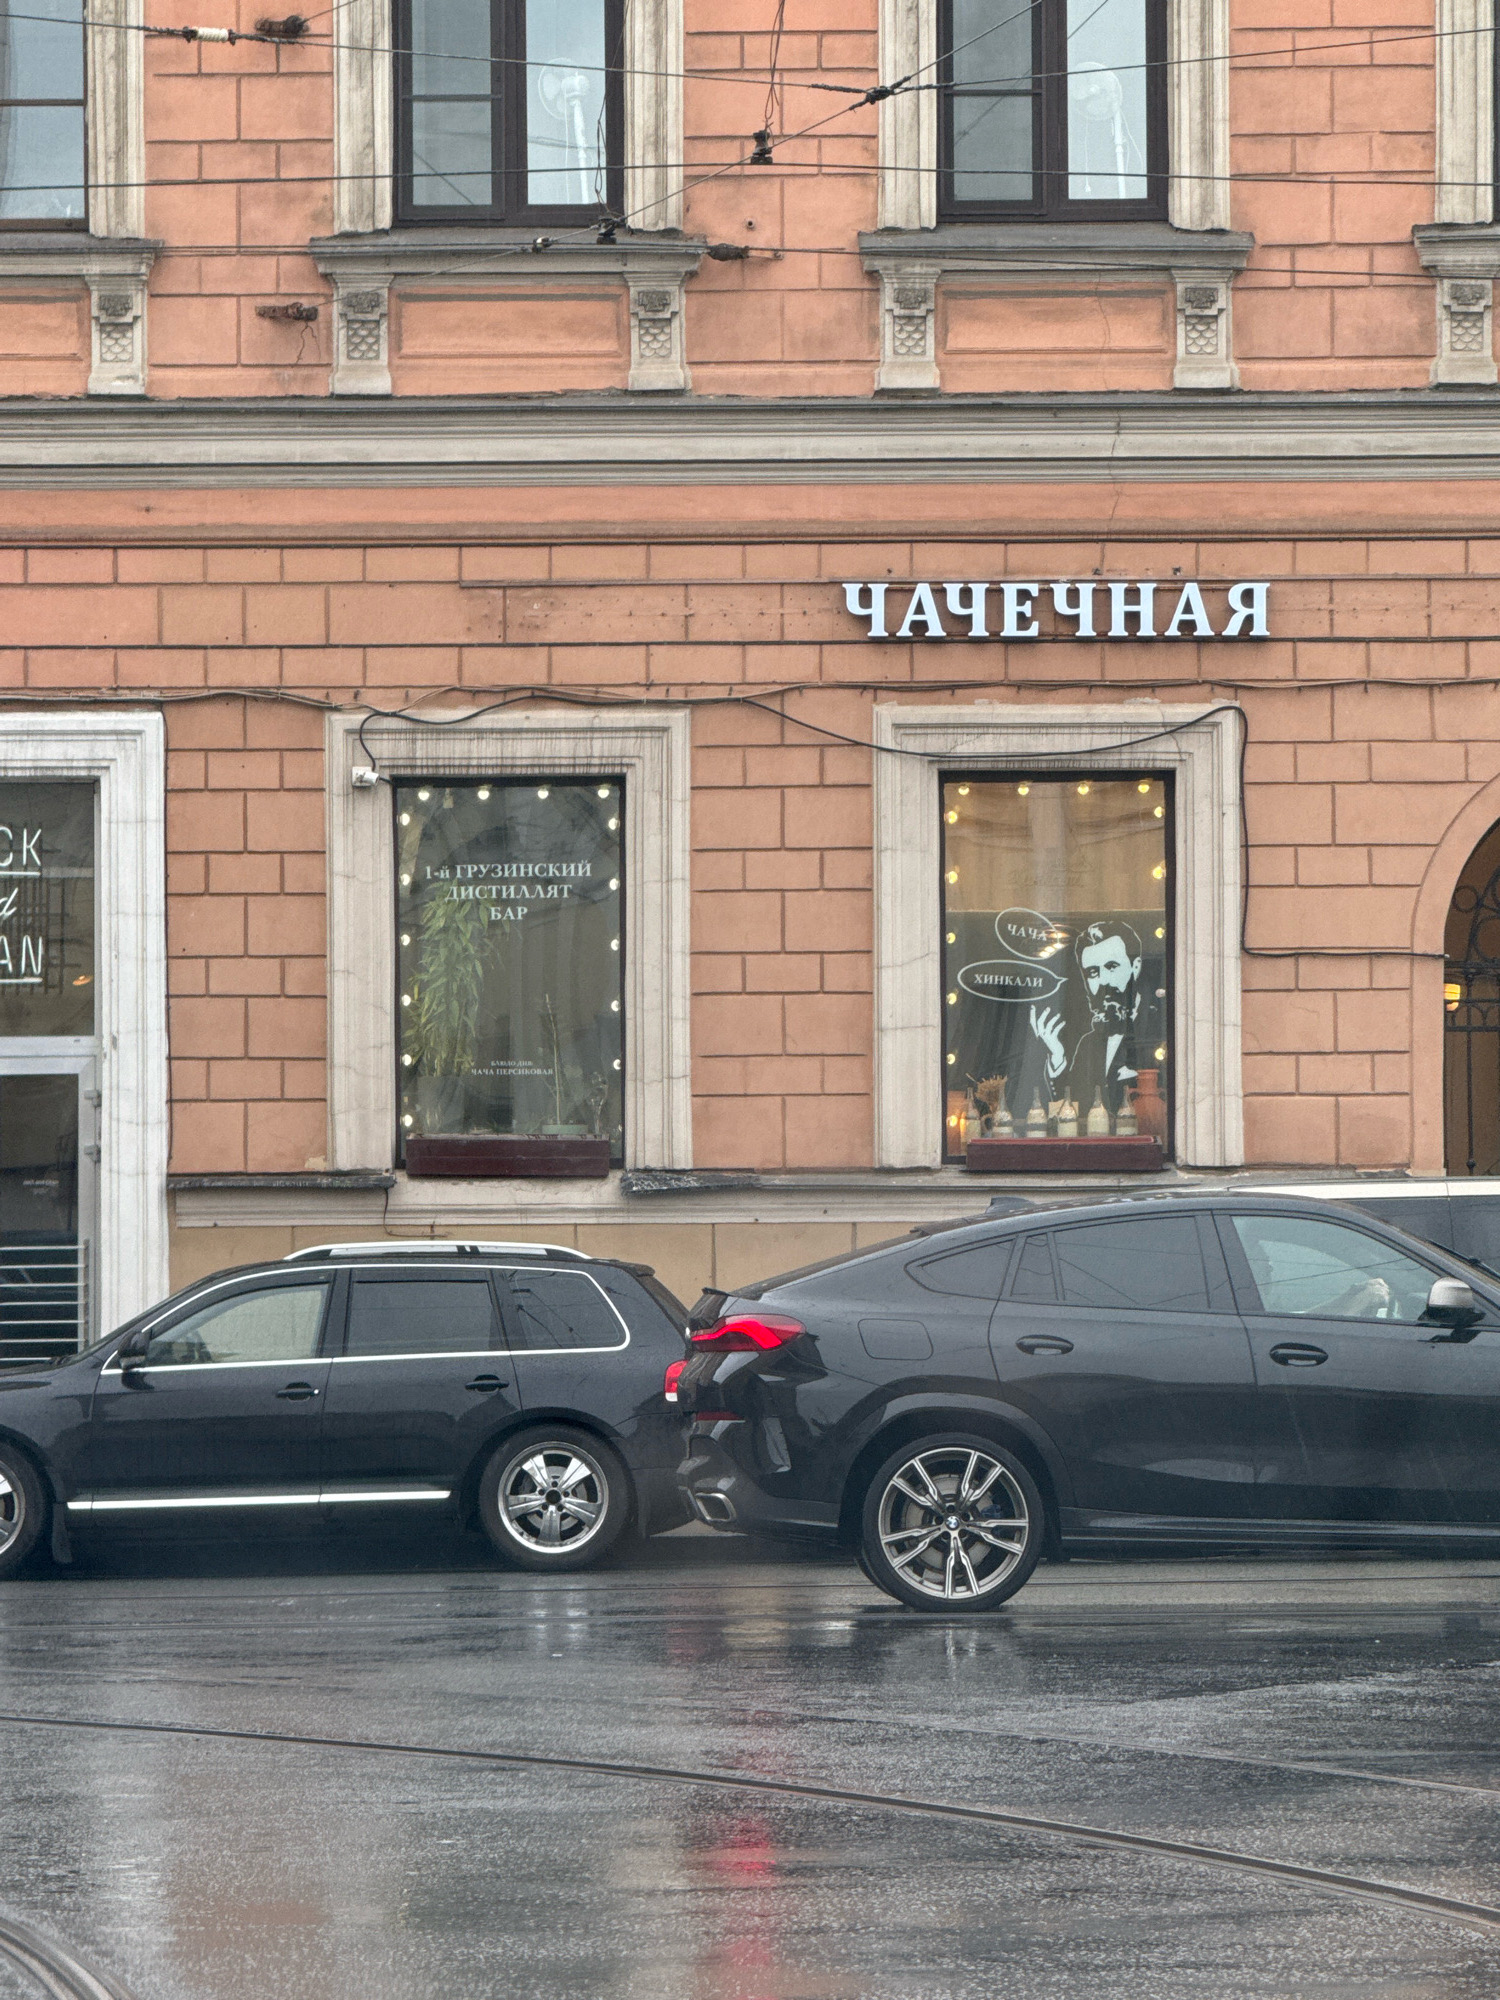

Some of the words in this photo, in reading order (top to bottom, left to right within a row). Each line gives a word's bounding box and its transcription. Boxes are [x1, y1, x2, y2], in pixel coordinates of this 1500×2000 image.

[842, 583, 1270, 637] ЧАЧЕЧНАЯ
[455, 859, 592, 878] ГРУЗИНСКИЙ
[445, 884, 573, 903] ДИСТИЛЛЯТ
[490, 906, 528, 921] БАР
[1007, 923, 1047, 941] ЧАЧА
[974, 973, 1043, 988] ХИНКАЛИ
[471, 1068, 494, 1076] ЧАЧА
